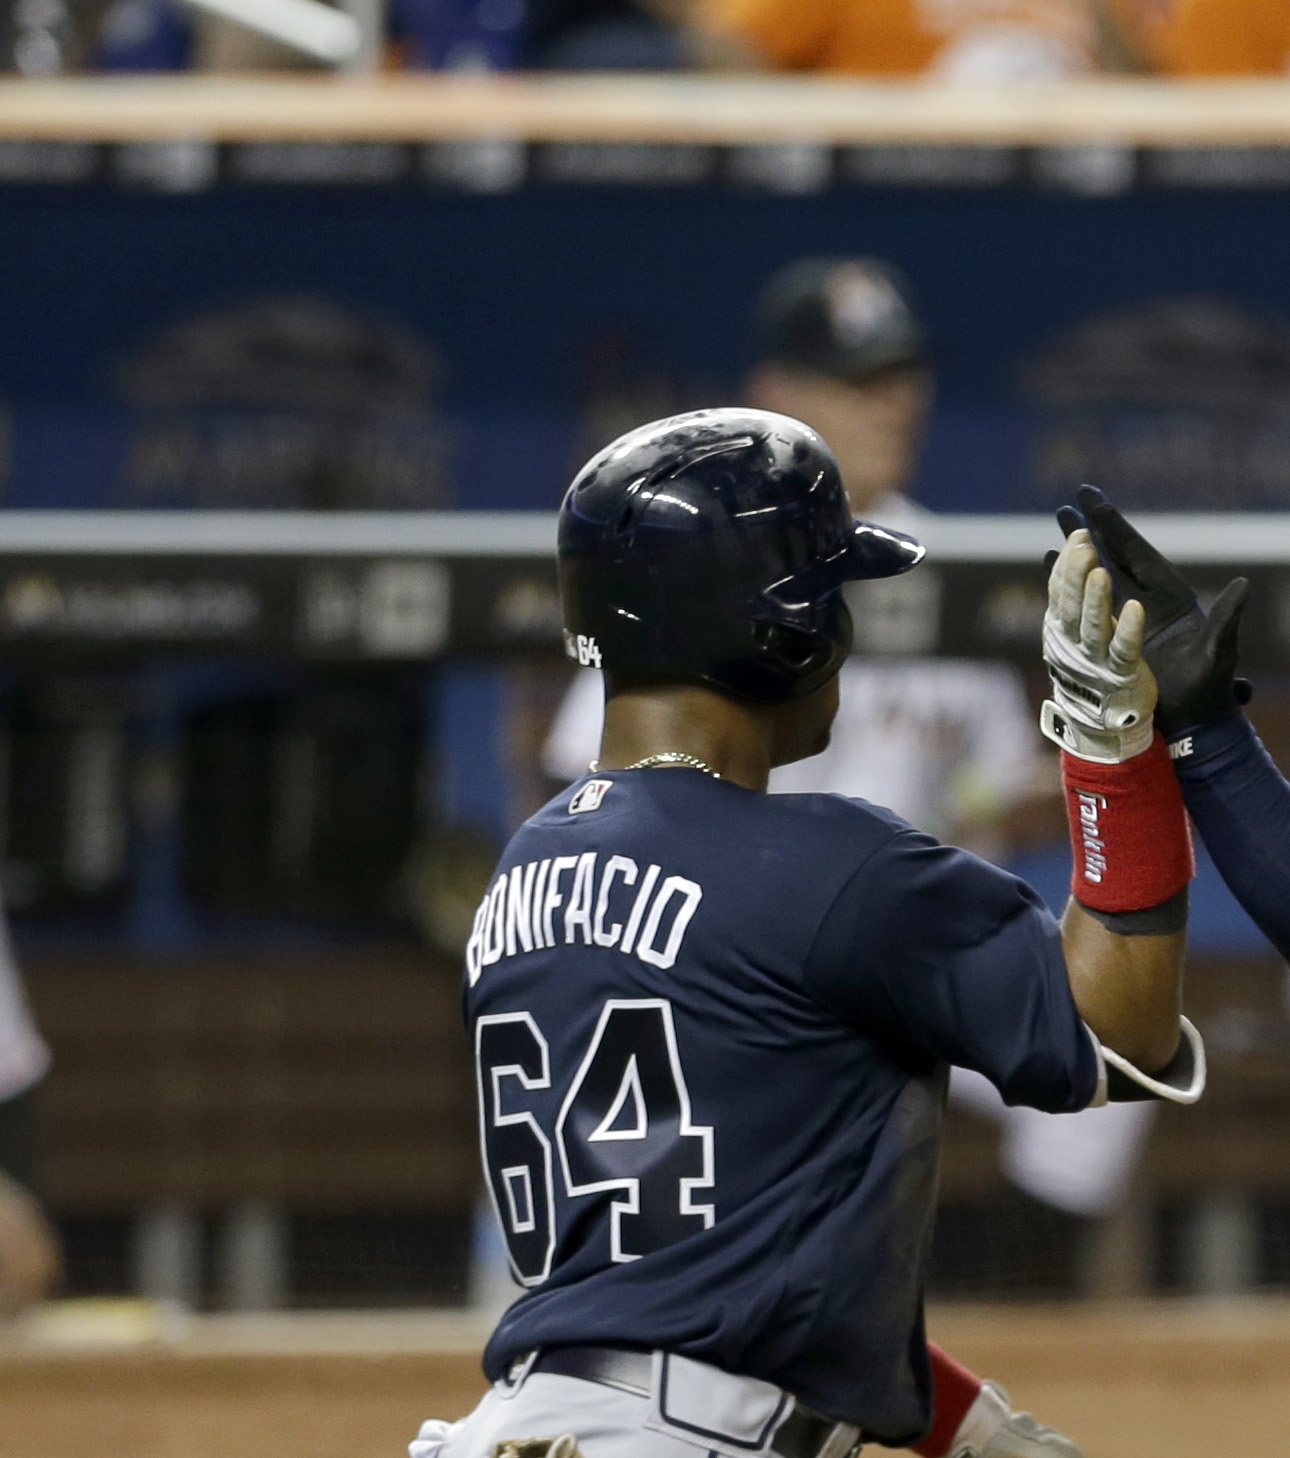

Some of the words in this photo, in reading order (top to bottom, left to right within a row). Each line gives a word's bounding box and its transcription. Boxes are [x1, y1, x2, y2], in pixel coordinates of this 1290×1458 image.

[577, 634, 602, 669] 64
[465, 852, 703, 989] BONIFACIO
[475, 998, 716, 1289] 64
